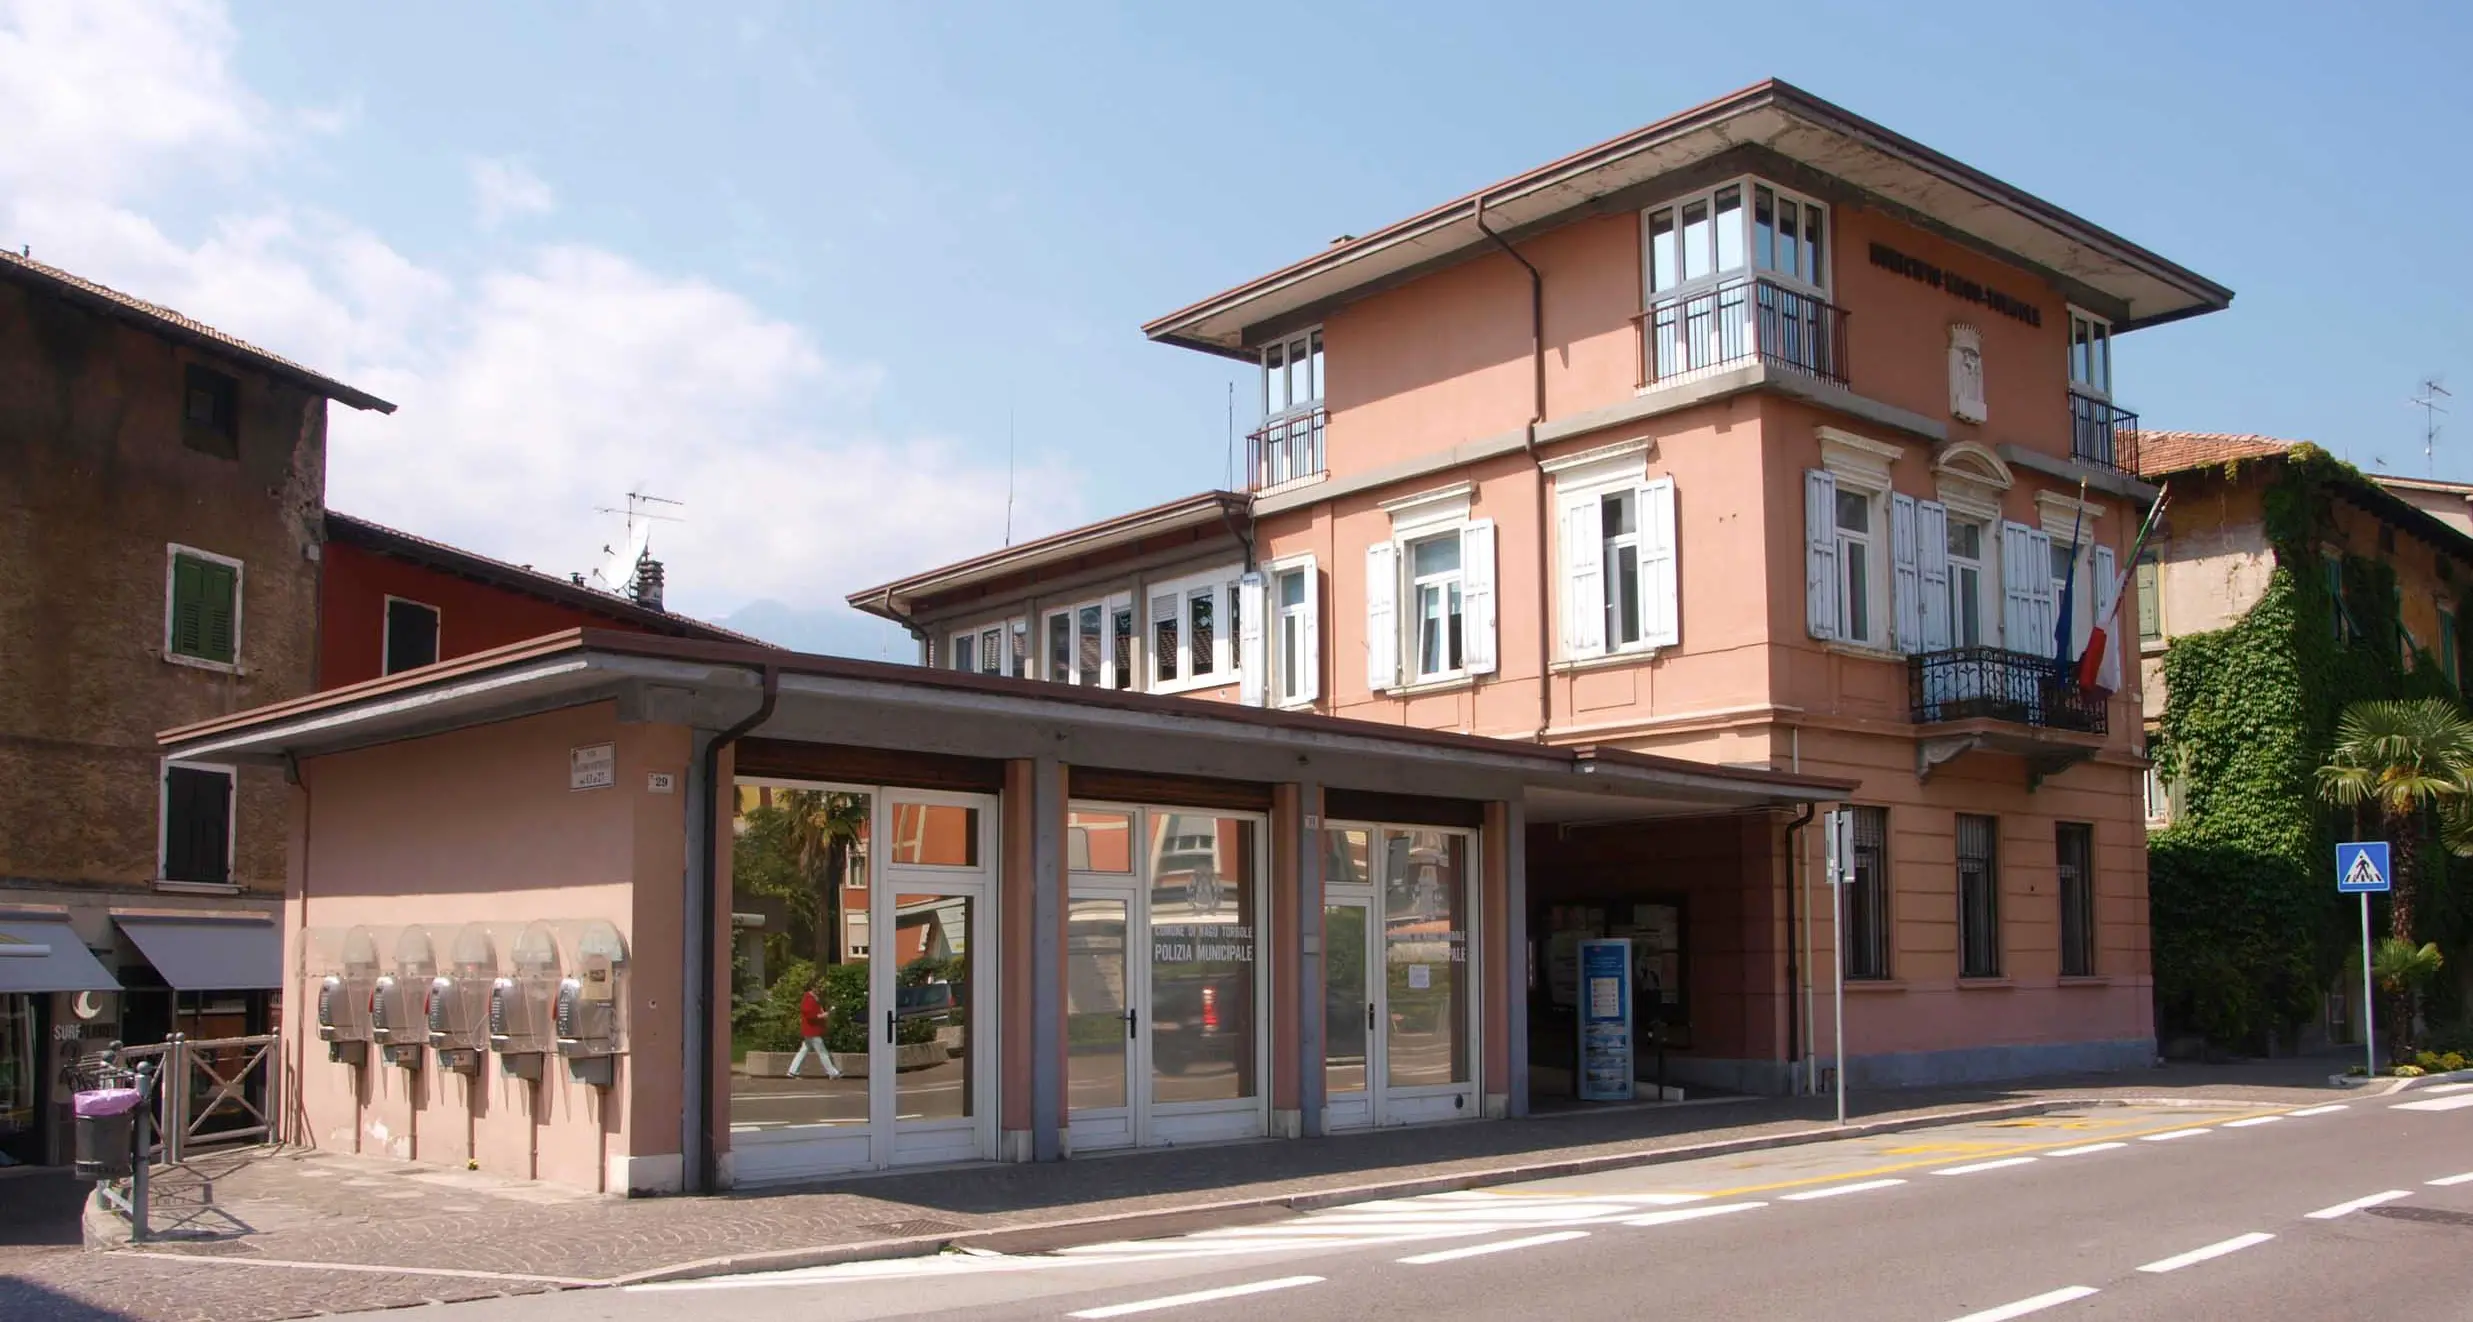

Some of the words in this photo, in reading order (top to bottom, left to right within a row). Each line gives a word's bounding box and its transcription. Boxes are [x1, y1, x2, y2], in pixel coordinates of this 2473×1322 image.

[655, 776, 668, 787] 29
[1154, 943, 1193, 961] POLIZIA
[1197, 944, 1253, 962] MUNICIPALE
